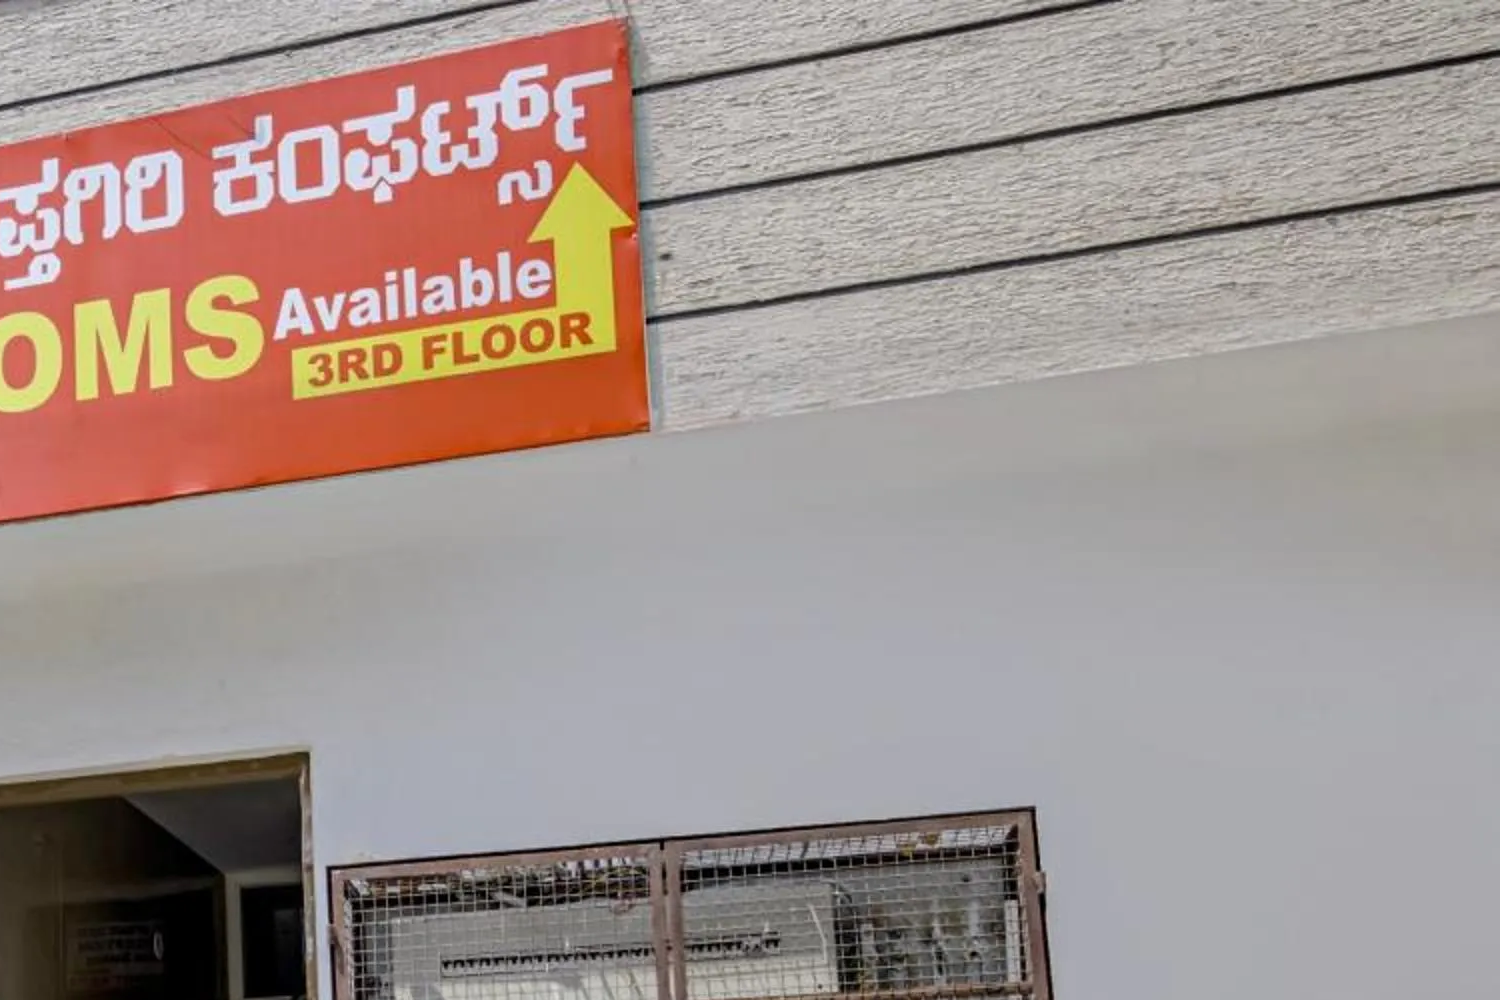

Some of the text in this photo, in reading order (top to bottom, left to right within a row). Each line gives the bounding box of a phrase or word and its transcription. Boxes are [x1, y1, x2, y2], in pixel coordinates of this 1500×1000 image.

[273, 251, 553, 341] Available
[308, 311, 595, 388] 3RD FLOOR
